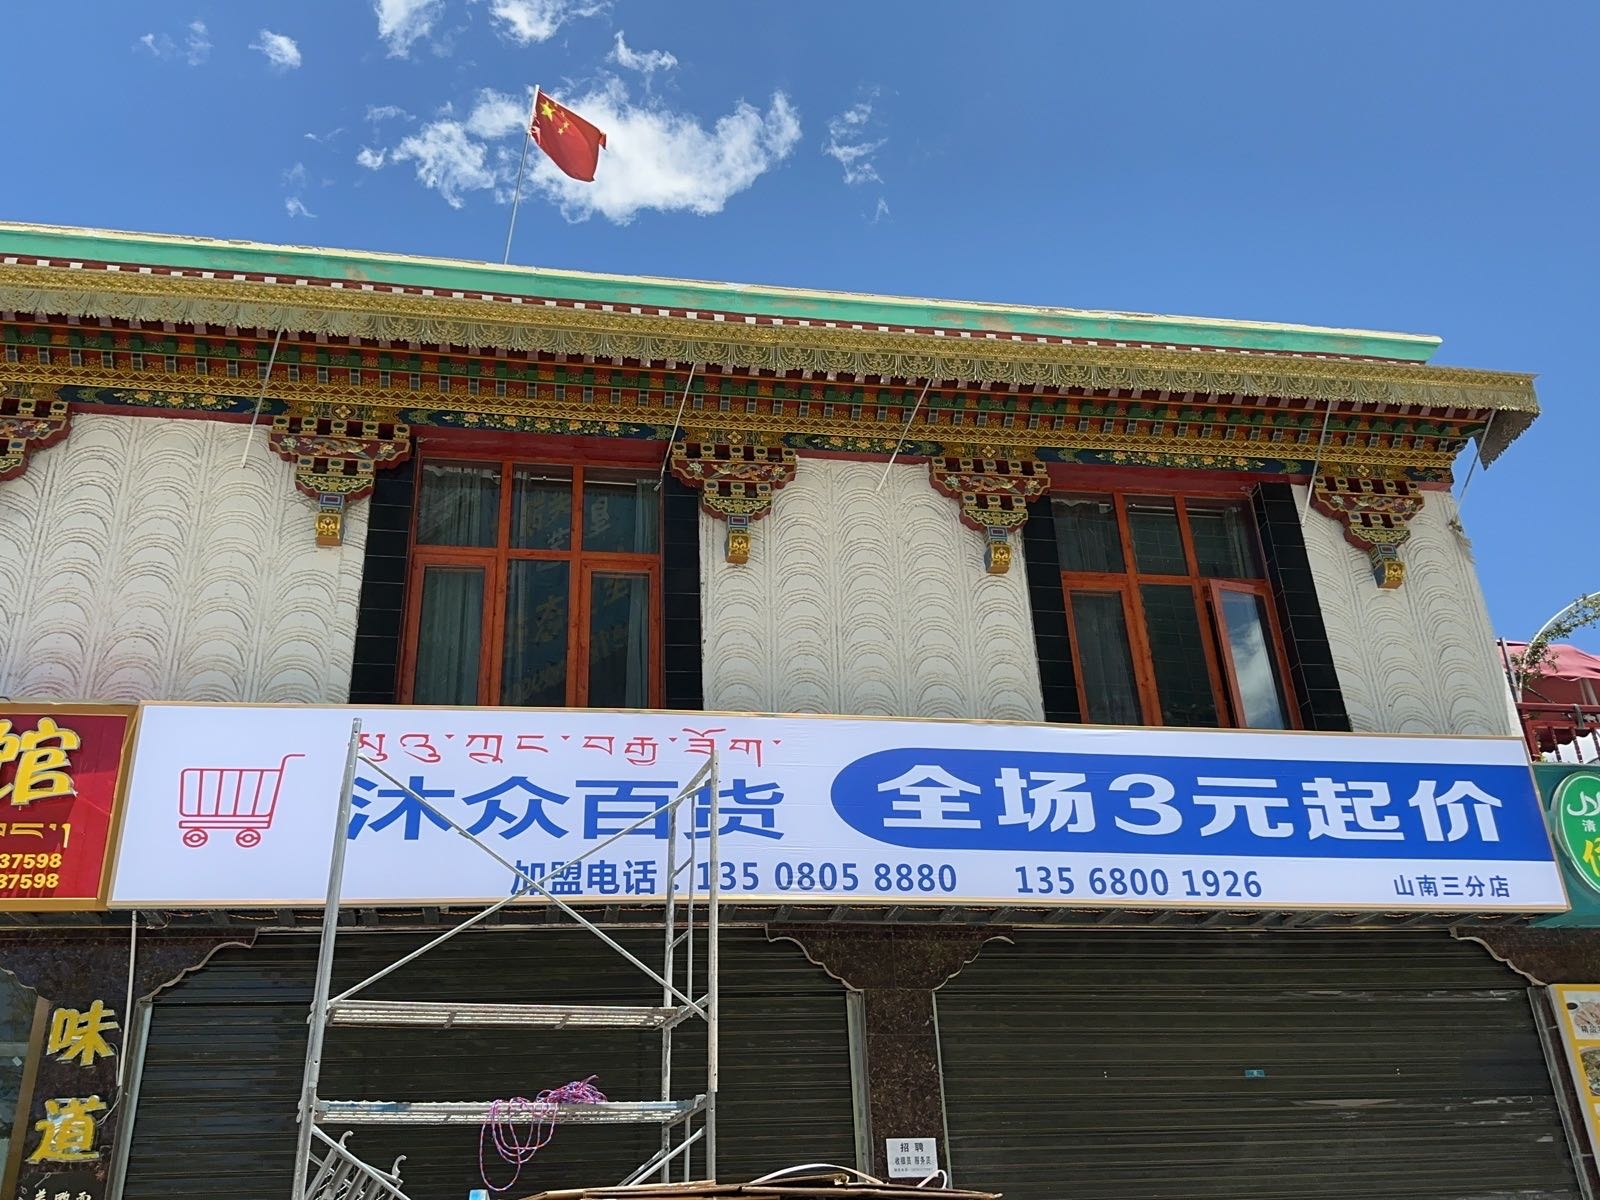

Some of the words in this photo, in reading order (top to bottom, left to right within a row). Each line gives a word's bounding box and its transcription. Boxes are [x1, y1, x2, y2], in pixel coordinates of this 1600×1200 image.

[0, 717, 80, 806] 馆
[347, 775, 785, 841] 沐众百货
[877, 764, 1502, 842] 全场3元起价
[697, 861, 759, 891] 135
[775, 862, 859, 892] 0805
[874, 863, 957, 892] 8880
[1015, 866, 1075, 895] 135
[1088, 868, 1169, 896] 6800
[1182, 870, 1262, 898] 1926
[1393, 874, 1510, 898] 山南三分店
[25, 999, 121, 1165] 味道
